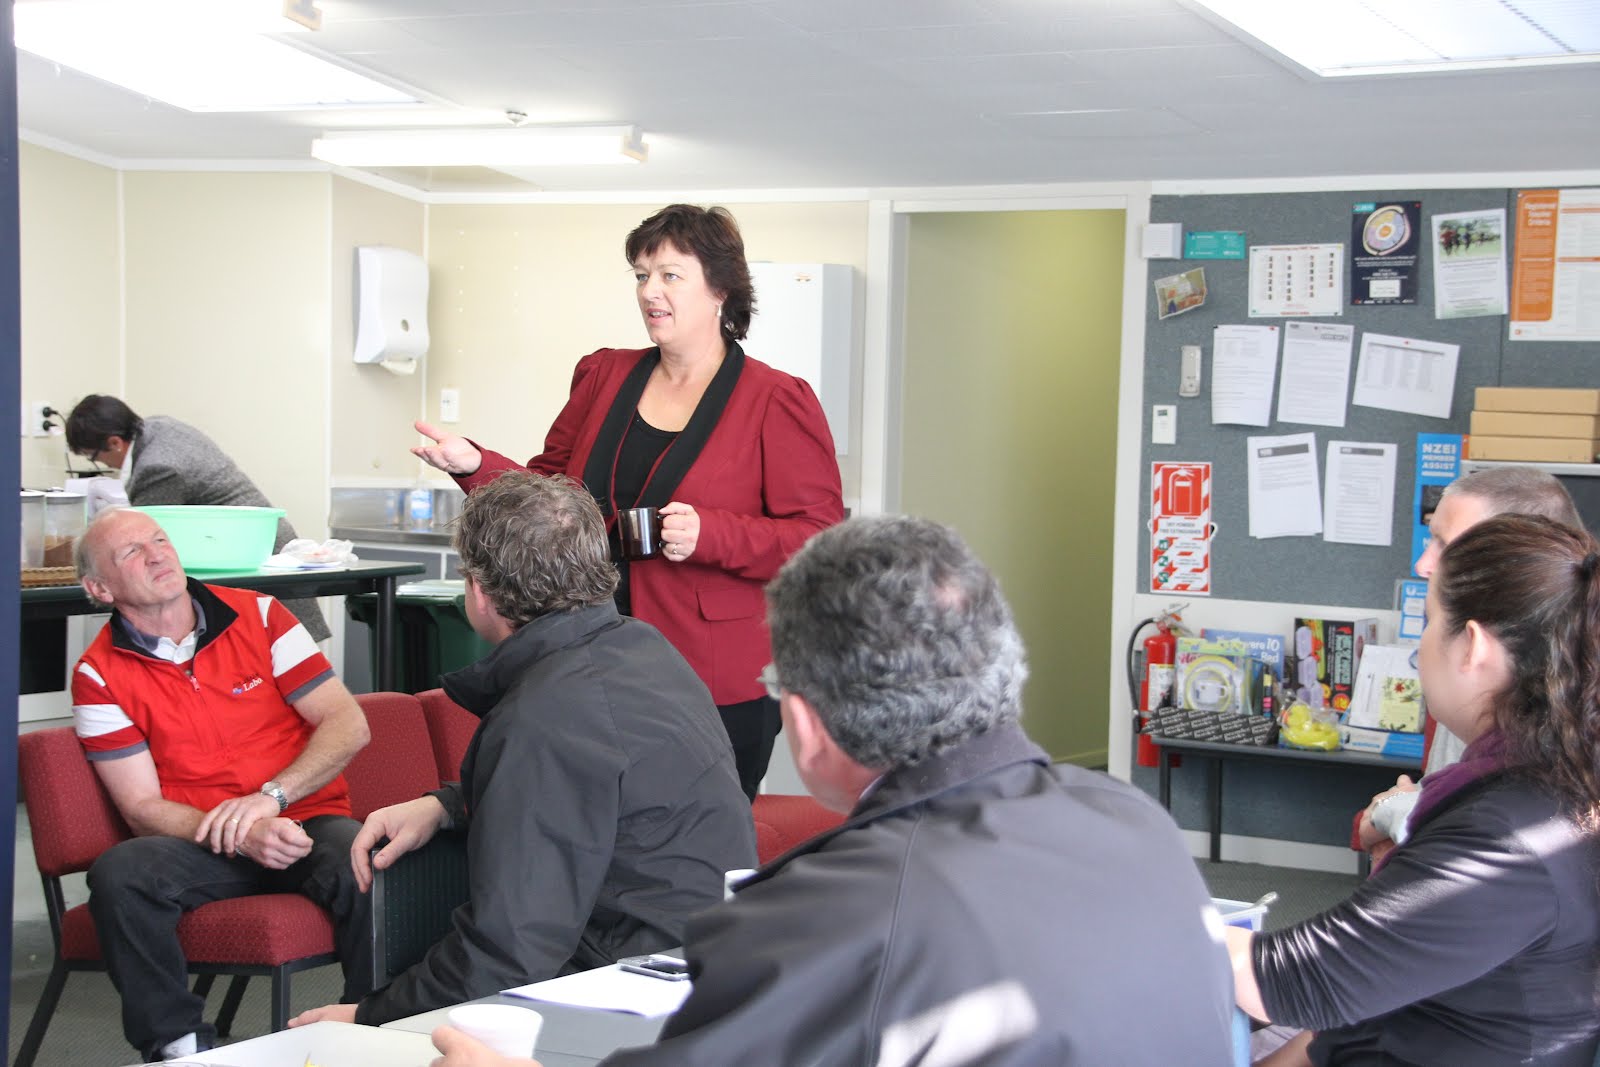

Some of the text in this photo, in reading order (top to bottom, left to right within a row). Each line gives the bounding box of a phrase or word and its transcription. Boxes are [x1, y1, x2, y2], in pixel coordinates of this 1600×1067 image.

[1422, 443, 1456, 454] NZEI
[1266, 638, 1280, 651] 10
[243, 677, 263, 692] Labo
